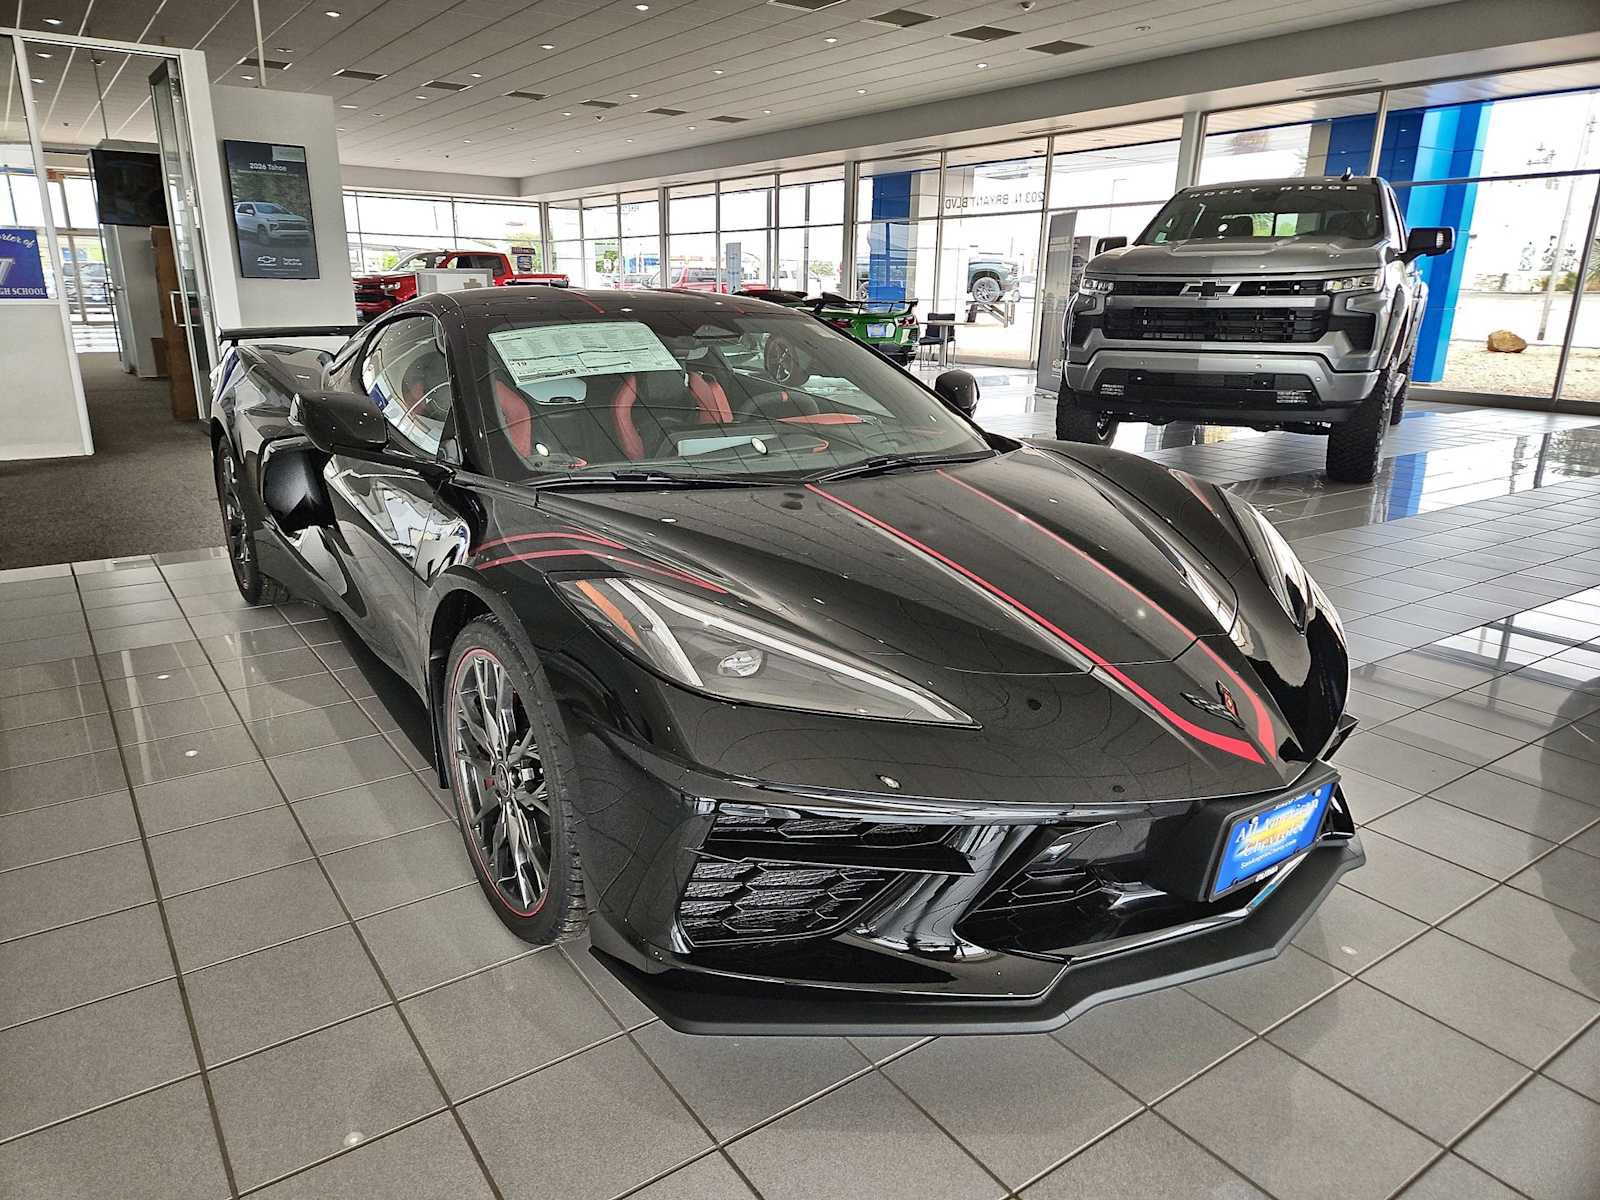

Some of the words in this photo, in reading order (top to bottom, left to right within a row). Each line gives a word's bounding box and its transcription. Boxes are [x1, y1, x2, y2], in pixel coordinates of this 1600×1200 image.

[1190, 187, 1261, 198] ROCKY
[12, 287, 46, 296] SCHOOL
[1235, 821, 1259, 844] All
